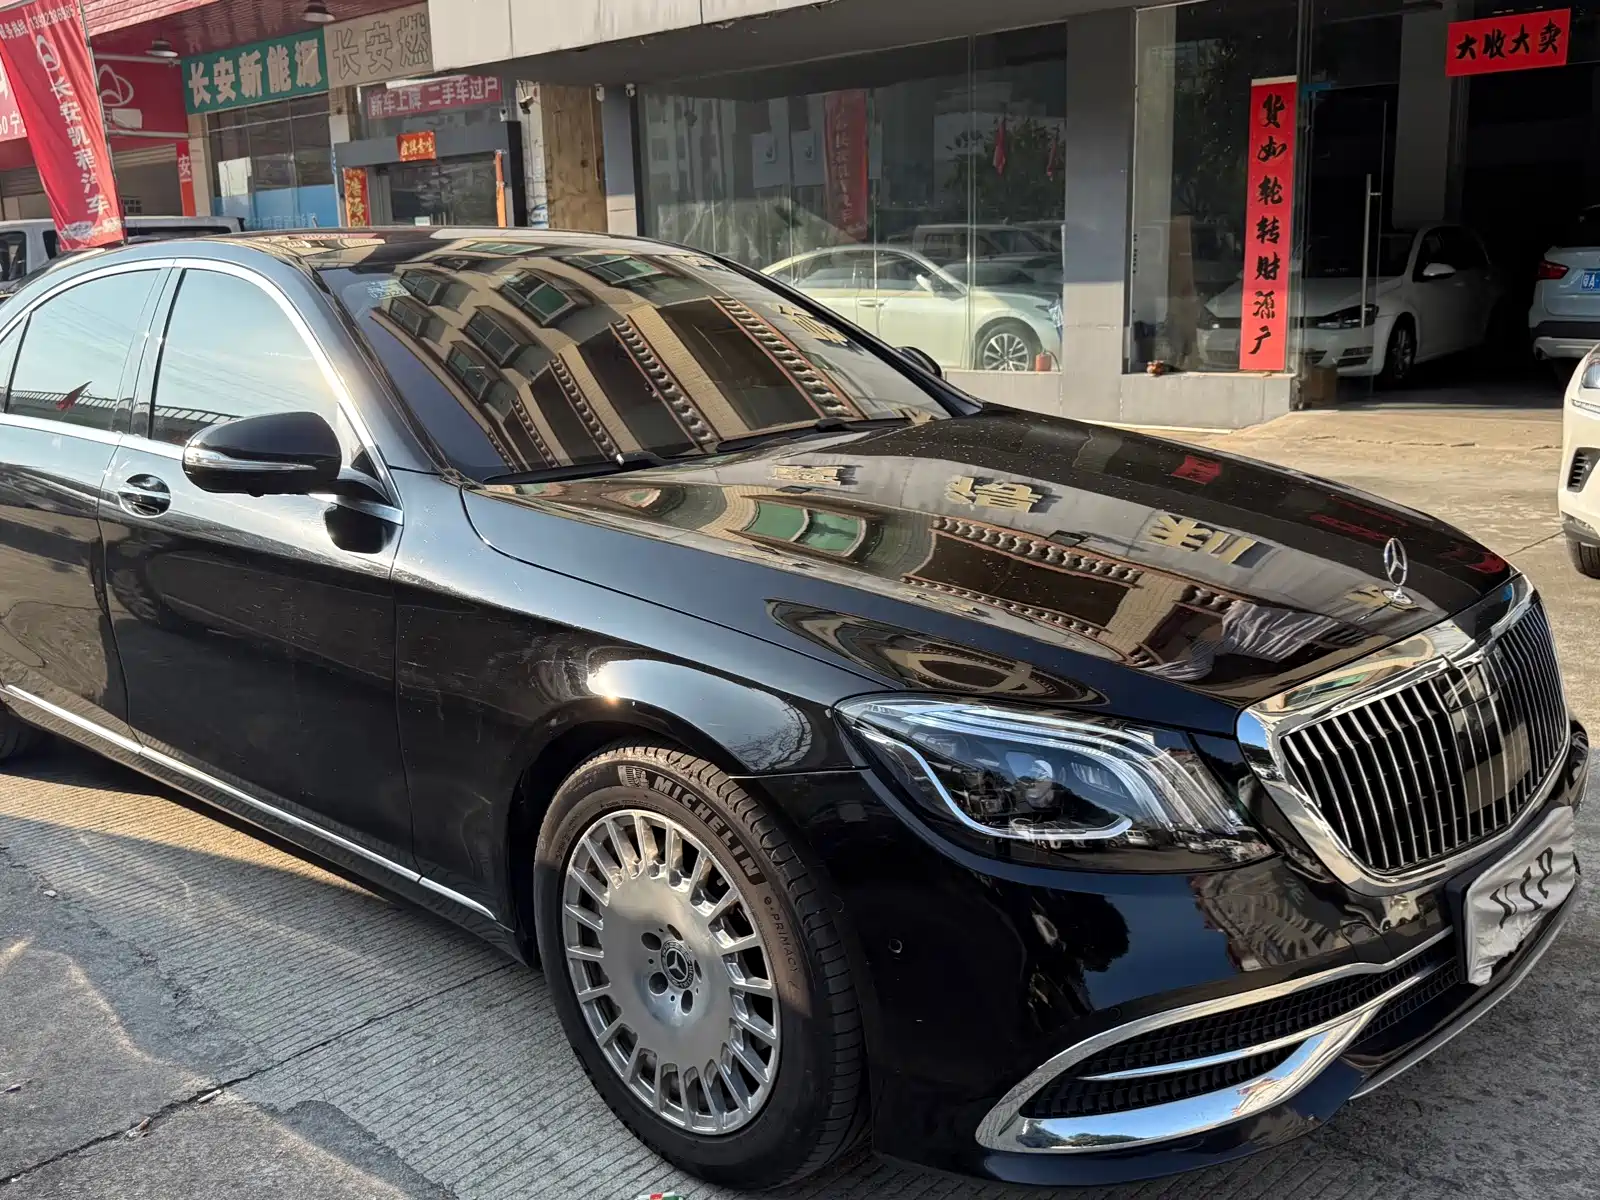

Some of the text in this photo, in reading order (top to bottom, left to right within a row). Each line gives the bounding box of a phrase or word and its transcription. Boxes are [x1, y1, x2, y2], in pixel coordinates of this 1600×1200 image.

[188, 38, 322, 108] 长安新能源
[1454, 17, 1562, 60] 大收大卖
[428, 76, 498, 105] 二手车过户
[1249, 93, 1287, 355] 货如轮转财源广
[653, 775, 761, 878] MICHELIN
